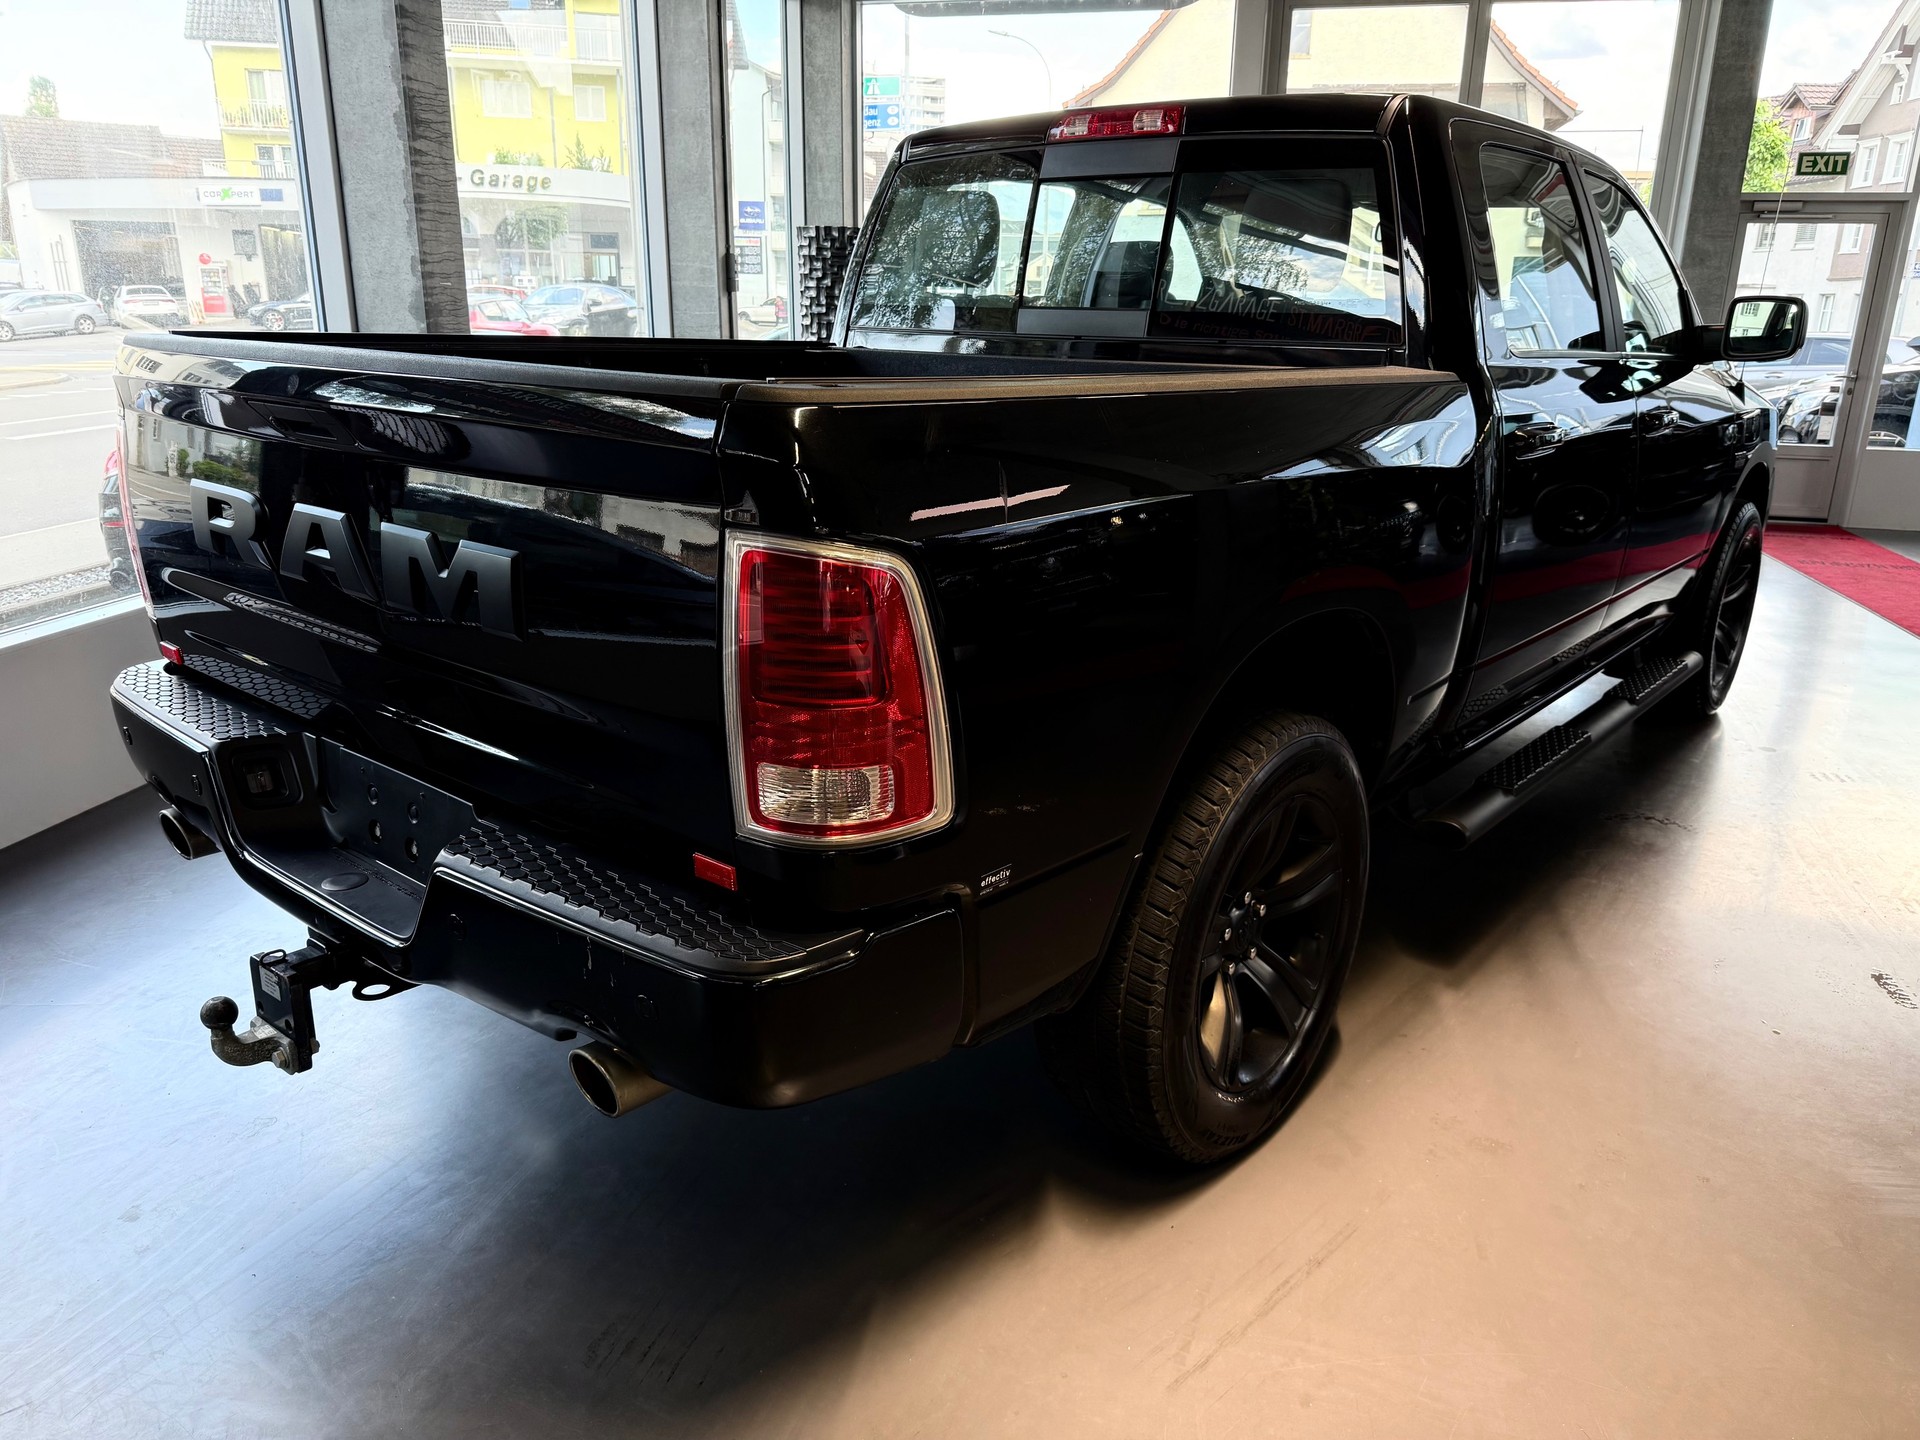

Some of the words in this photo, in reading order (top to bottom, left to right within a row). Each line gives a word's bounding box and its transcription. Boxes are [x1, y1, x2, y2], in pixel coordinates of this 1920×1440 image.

[1801, 156, 1847, 172] EXIT
[470, 169, 552, 193] Garage
[190, 478, 527, 643] RAM
